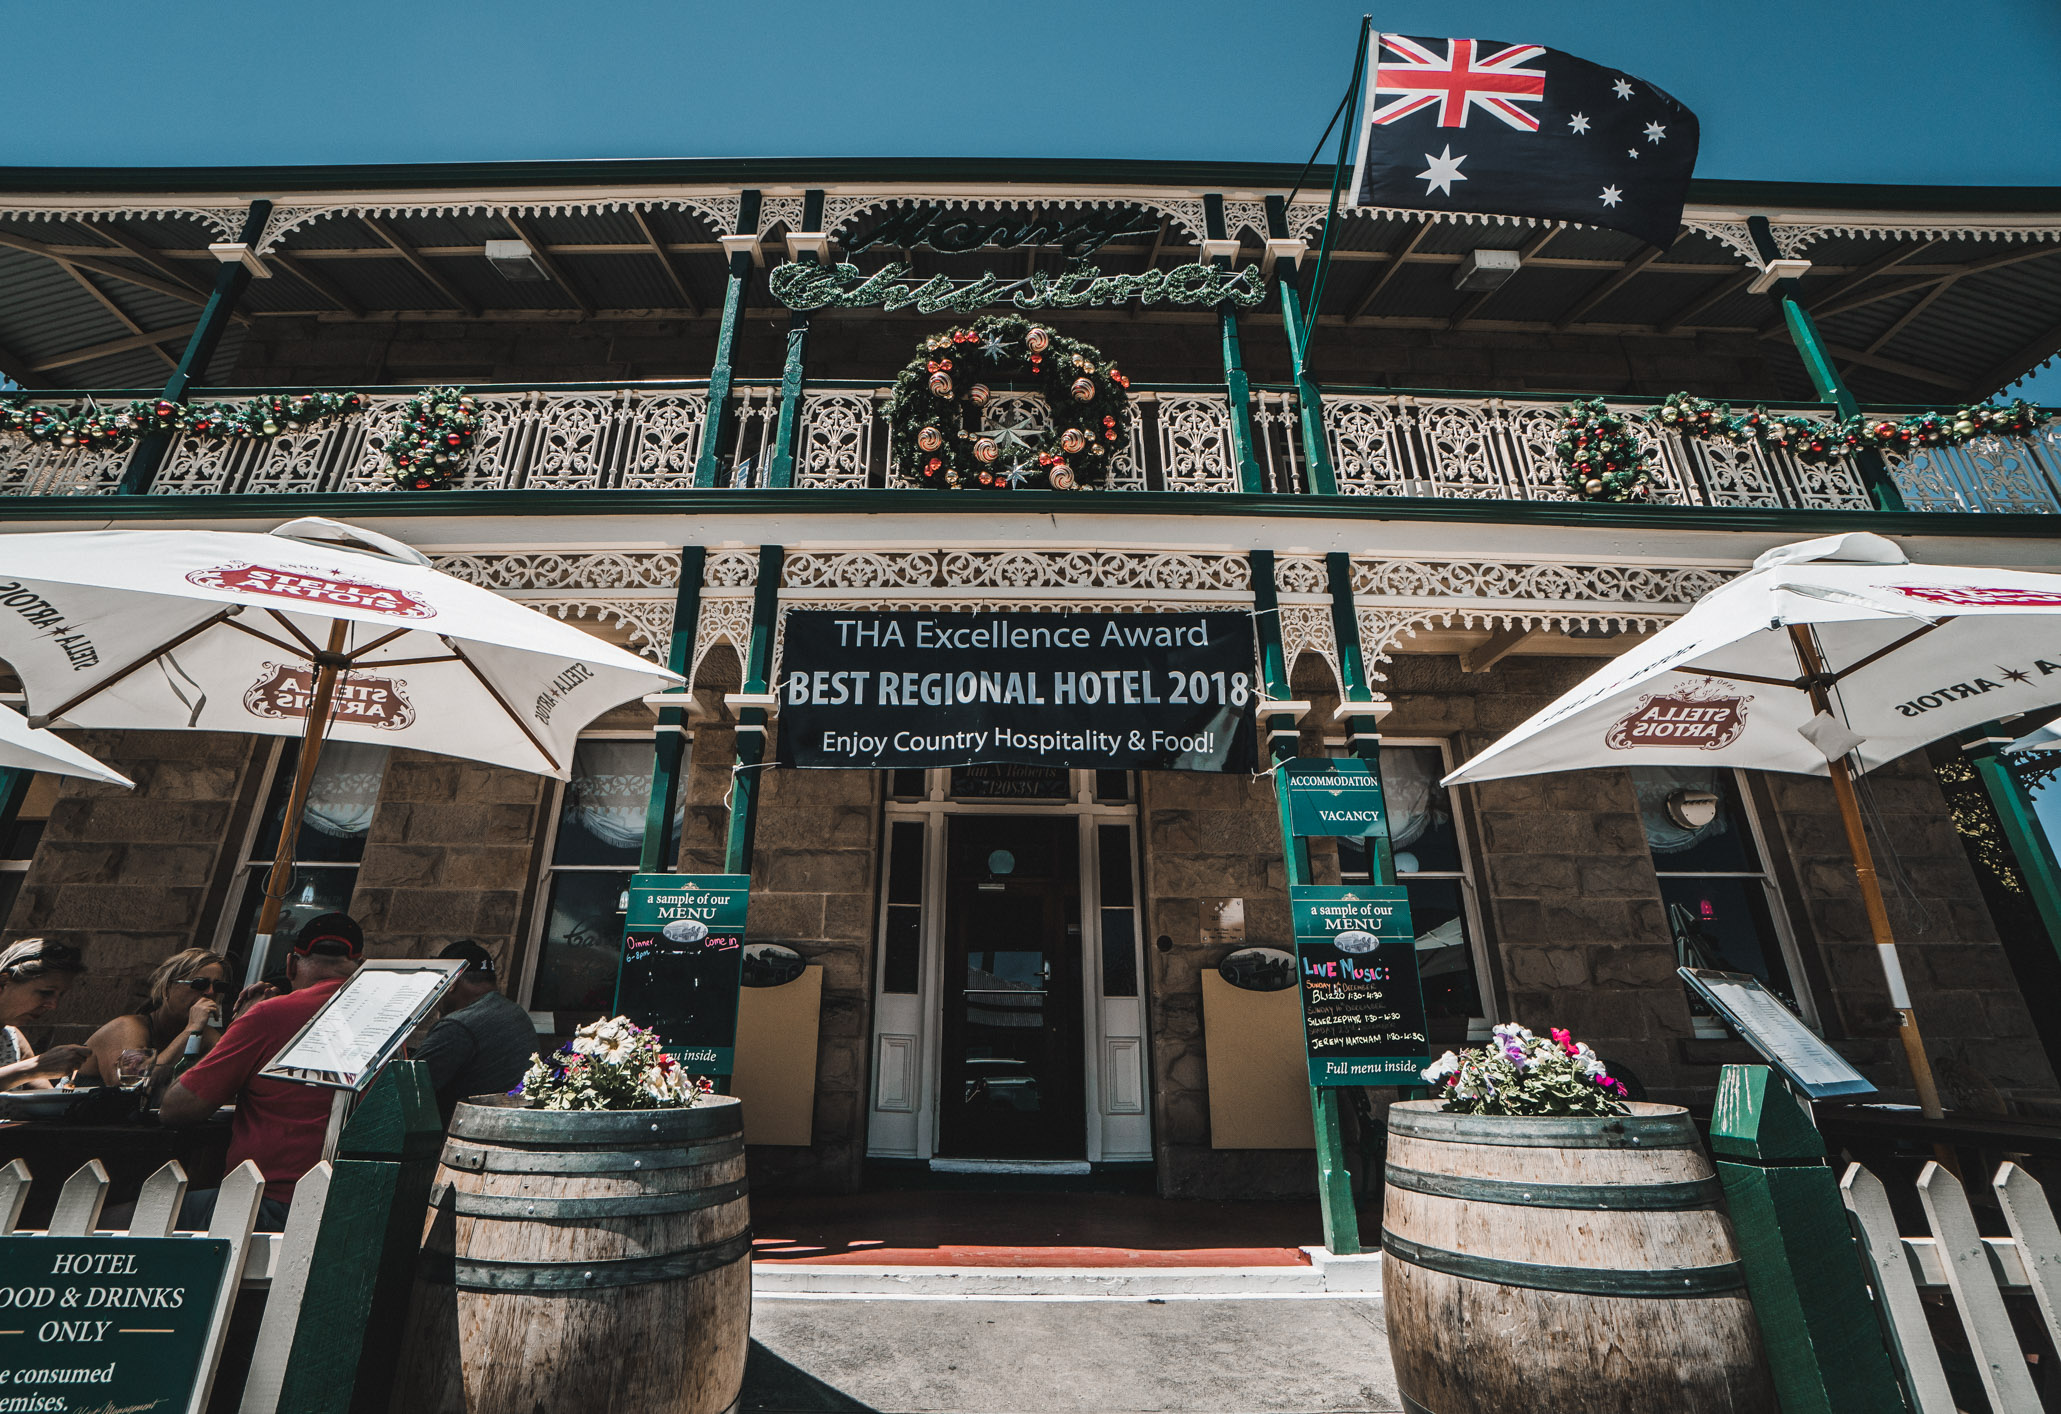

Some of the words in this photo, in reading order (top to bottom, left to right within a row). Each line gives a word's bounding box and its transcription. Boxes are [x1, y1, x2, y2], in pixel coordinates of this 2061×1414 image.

[769, 258, 1267, 314] Christmas
[248, 570, 402, 600] STELLA
[240, 578, 402, 609] ARTOIS
[834, 619, 905, 648] THA
[916, 619, 1091, 649] Excellence
[1100, 618, 1210, 647] Award
[787, 670, 870, 706] BEST
[878, 669, 1045, 706] REGIONAL
[1054, 669, 1161, 705] HOTEL
[1167, 670, 1249, 707] 2018
[822, 730, 889, 757] Enjoy
[893, 728, 988, 754] Country
[994, 726, 1124, 758] Hospitality
[1127, 730, 1146, 752] &
[1151, 730, 1215, 754] Food!
[1290, 776, 1378, 787] ACCOMMODATION
[1319, 811, 1380, 822] VACANCY
[647, 895, 654, 905] a
[655, 892, 694, 908] sample
[696, 892, 710, 905] of
[710, 896, 731, 905] our
[656, 907, 718, 920] MENU
[1310, 906, 1318, 916] a
[1319, 903, 1358, 918] sample
[1359, 903, 1373, 916] of
[1373, 905, 1393, 916] our
[1324, 918, 1383, 931] MENU
[626, 935, 655, 951] Dinner
[704, 936, 727, 949] Come
[728, 934, 738, 945] in
[1302, 956, 1337, 979] LIVE
[1305, 978, 1331, 992] SUNDAY
[1342, 982, 1377, 993] DECEMBER
[1311, 1037, 1345, 1050] JEREMY
[683, 1049, 717, 1062] inside
[1325, 1061, 1348, 1075] Full
[1350, 1063, 1382, 1075] menu
[1384, 1059, 1418, 1073] inside
[50, 1253, 139, 1275] HOTEL
[0, 1286, 56, 1309] OOD
[59, 1286, 83, 1309] &
[83, 1286, 186, 1310] DRINKS
[38, 1320, 114, 1343] ONLY
[13, 1361, 117, 1385] consumed
